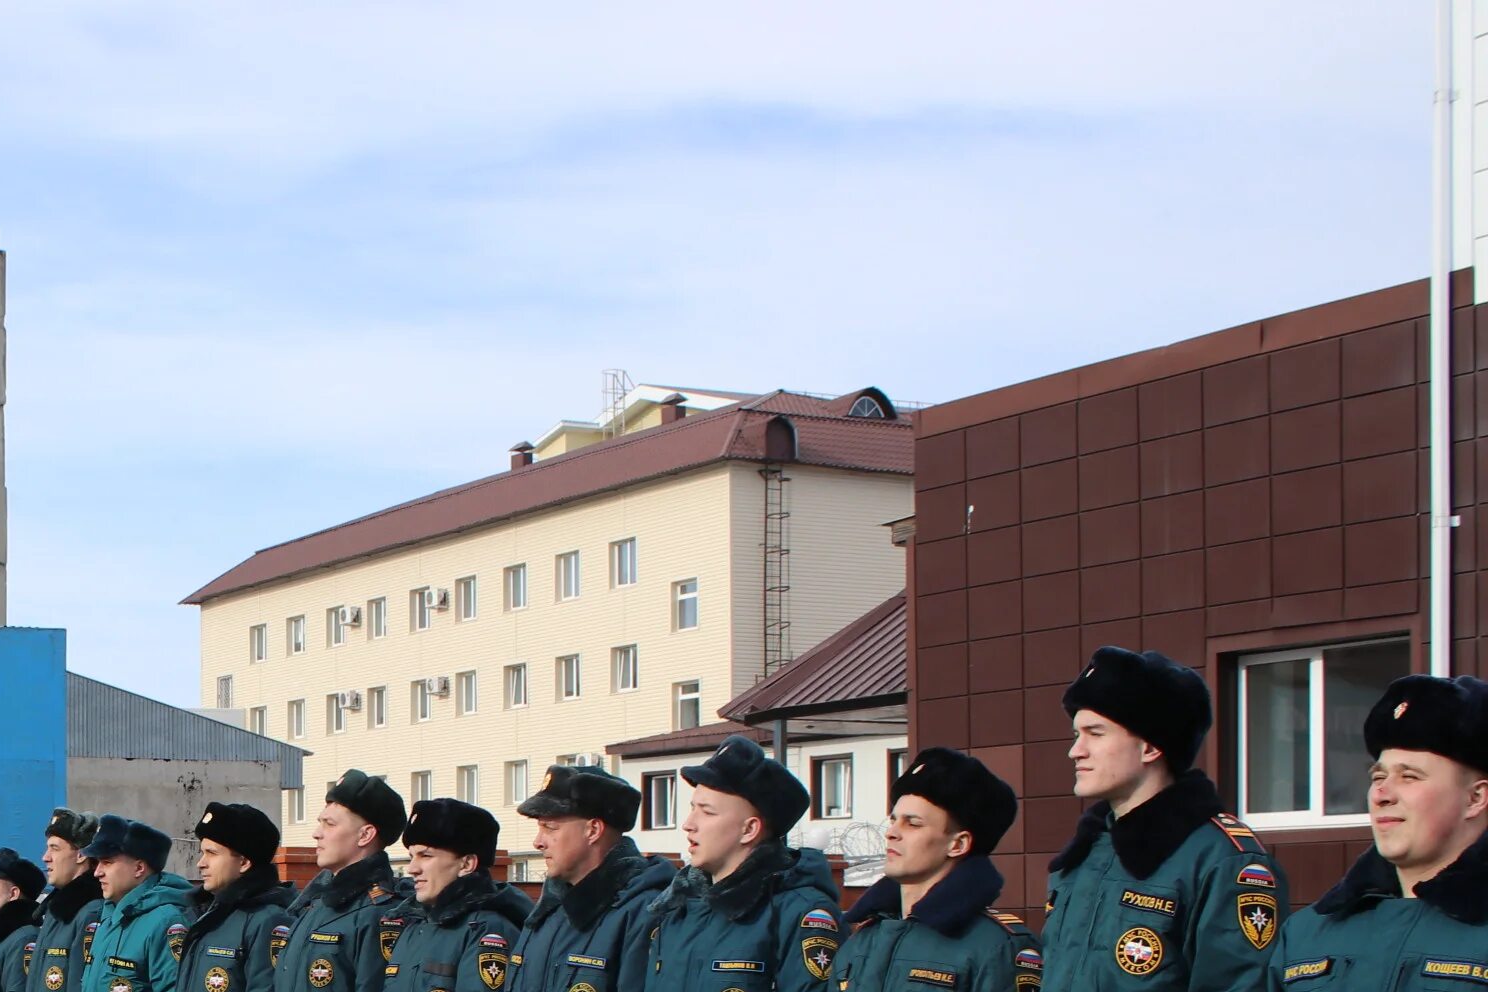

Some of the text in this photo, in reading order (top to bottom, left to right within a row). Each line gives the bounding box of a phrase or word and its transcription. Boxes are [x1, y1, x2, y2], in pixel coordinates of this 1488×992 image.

[1245, 877, 1268, 885] RUSSIA
[1154, 898, 1176, 913] Н.Е.
[1425, 961, 1471, 975] КОЩЕЕВ
